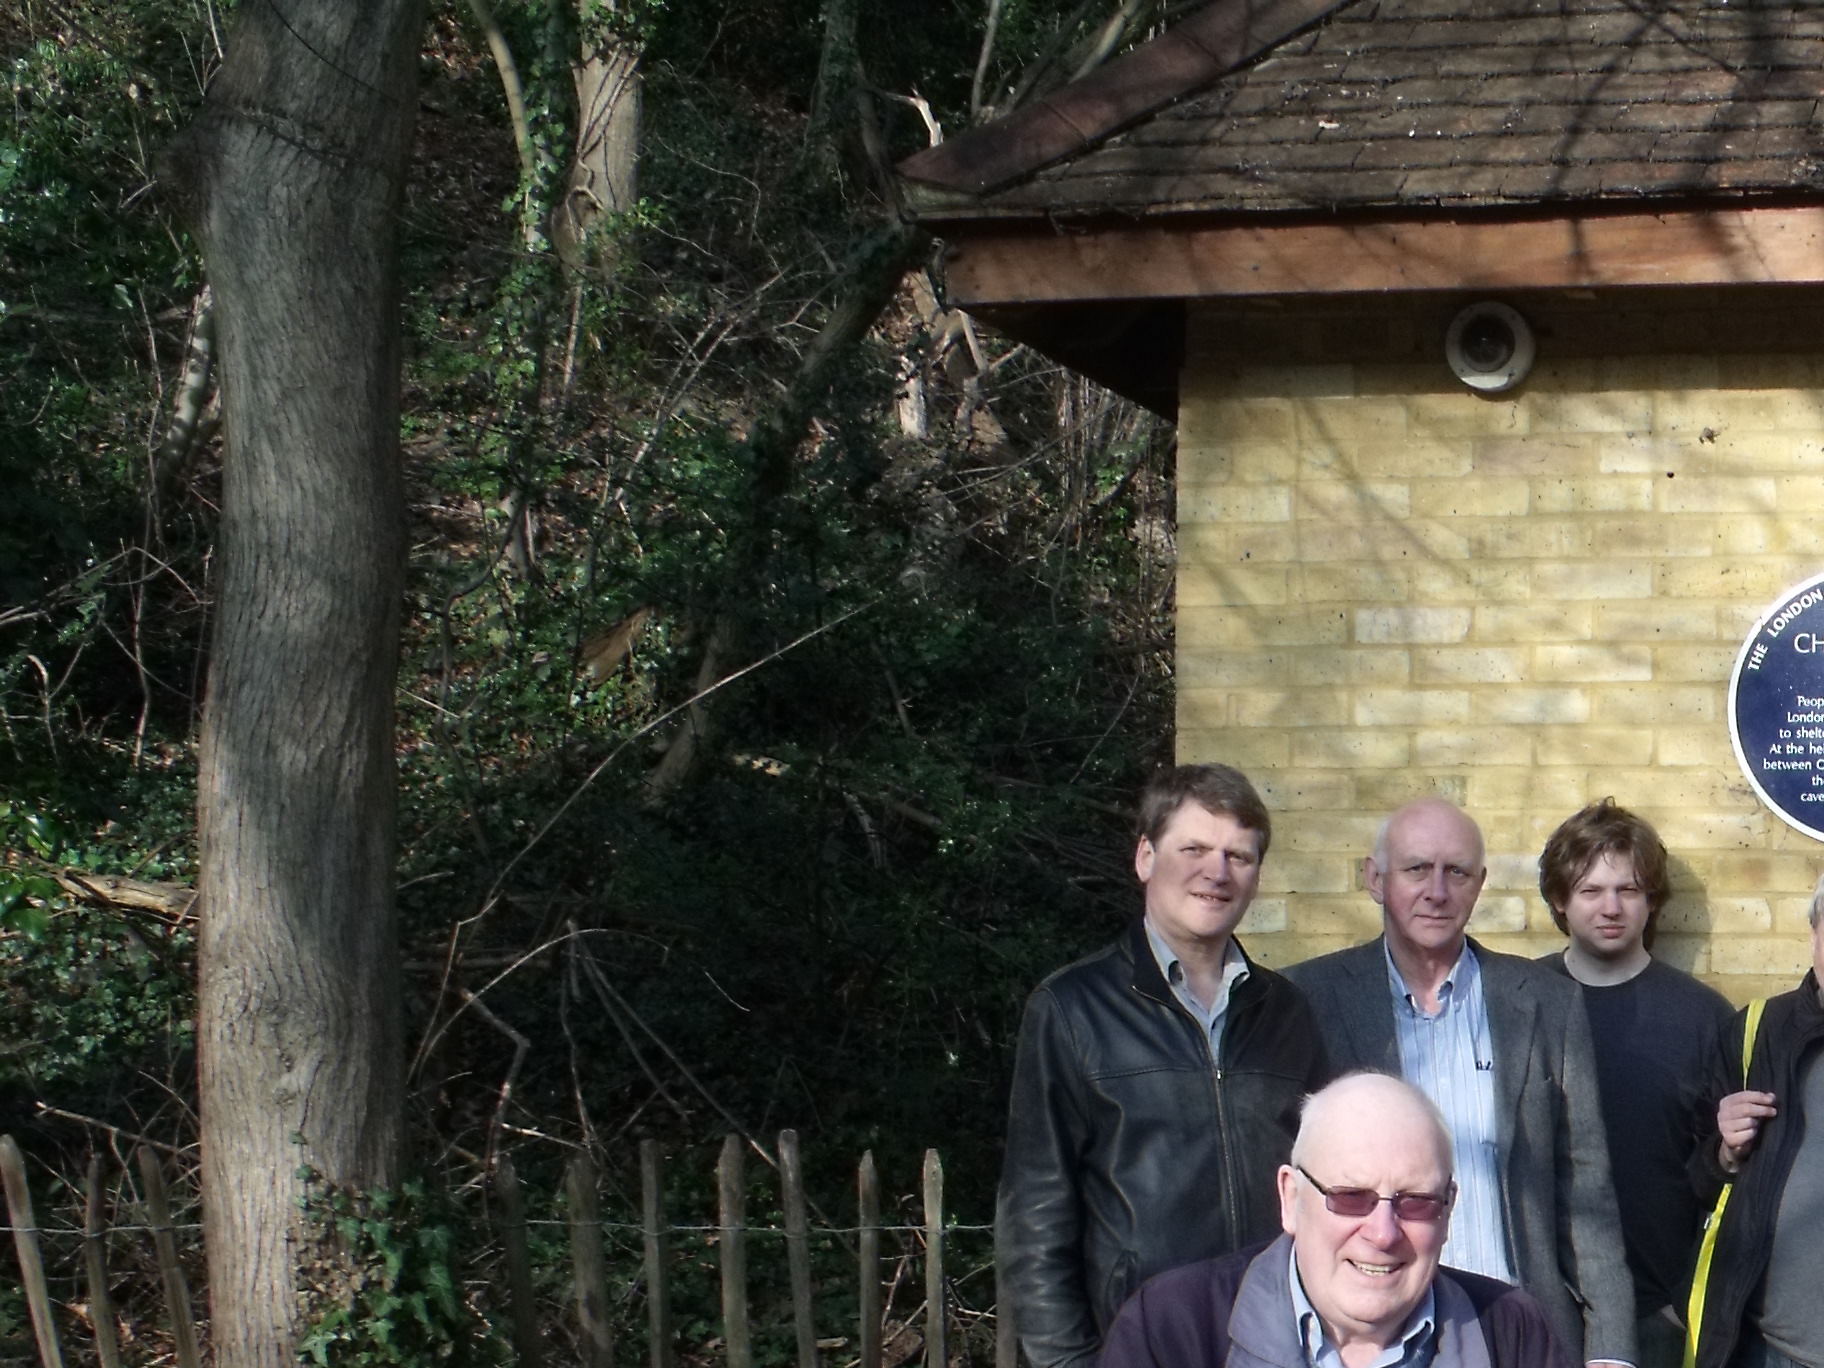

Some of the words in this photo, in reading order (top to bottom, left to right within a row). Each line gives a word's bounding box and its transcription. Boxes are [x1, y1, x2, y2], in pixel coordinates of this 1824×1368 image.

[1748, 643, 1769, 671] THE
[1767, 588, 1824, 637] LONDON
[1780, 730, 1791, 738] to
[1770, 744, 1781, 754] At
[1786, 744, 1804, 754] the
[1764, 759, 1811, 770] between
[1801, 793, 1824, 802] cave
